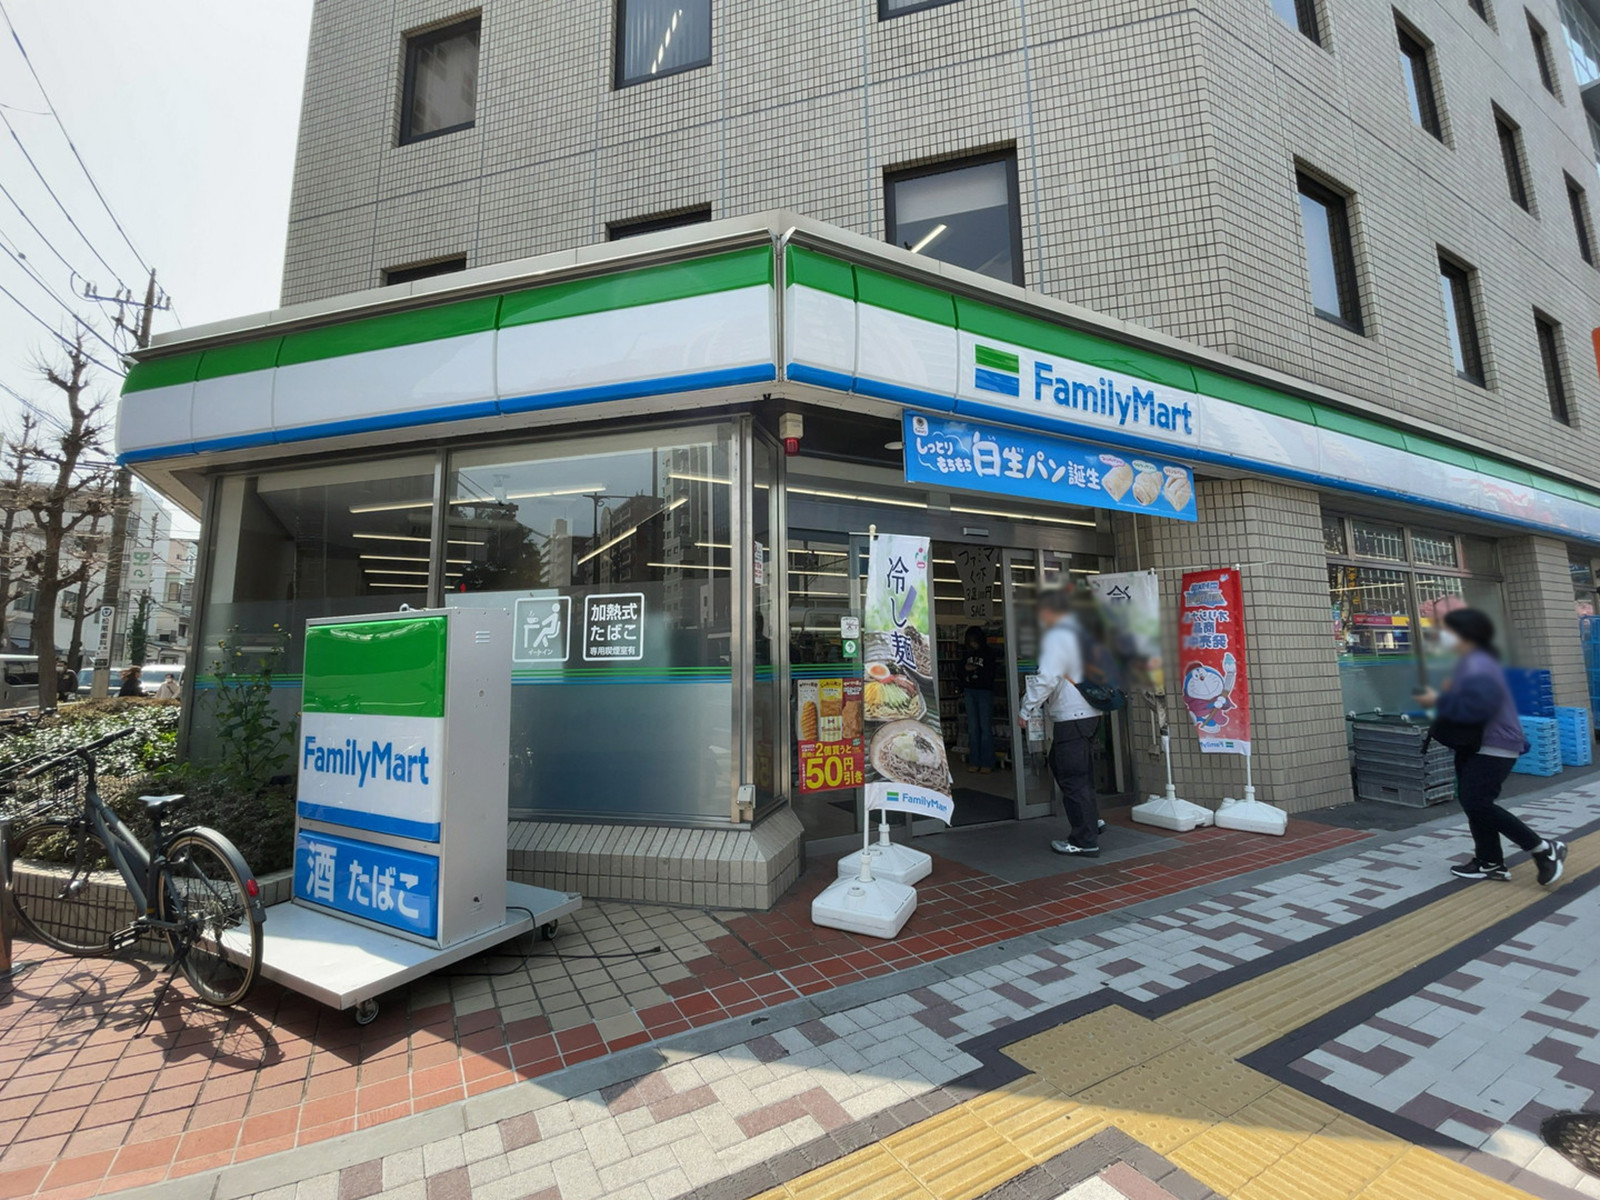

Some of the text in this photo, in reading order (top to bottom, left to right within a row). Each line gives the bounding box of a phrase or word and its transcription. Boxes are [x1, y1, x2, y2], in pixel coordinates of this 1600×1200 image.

[1034, 361, 1192, 435] FamilyMart
[916, 437, 953, 455] しっとり
[936, 456, 972, 473] もちもち
[973, 431, 1101, 490] 白生パン誕生
[590, 603, 638, 621] 加熱式
[590, 624, 637, 641] たばこ
[887, 556, 917, 670] 冷し麺
[304, 736, 429, 788] FamilyMart
[306, 841, 420, 919] 酒 たばこ
